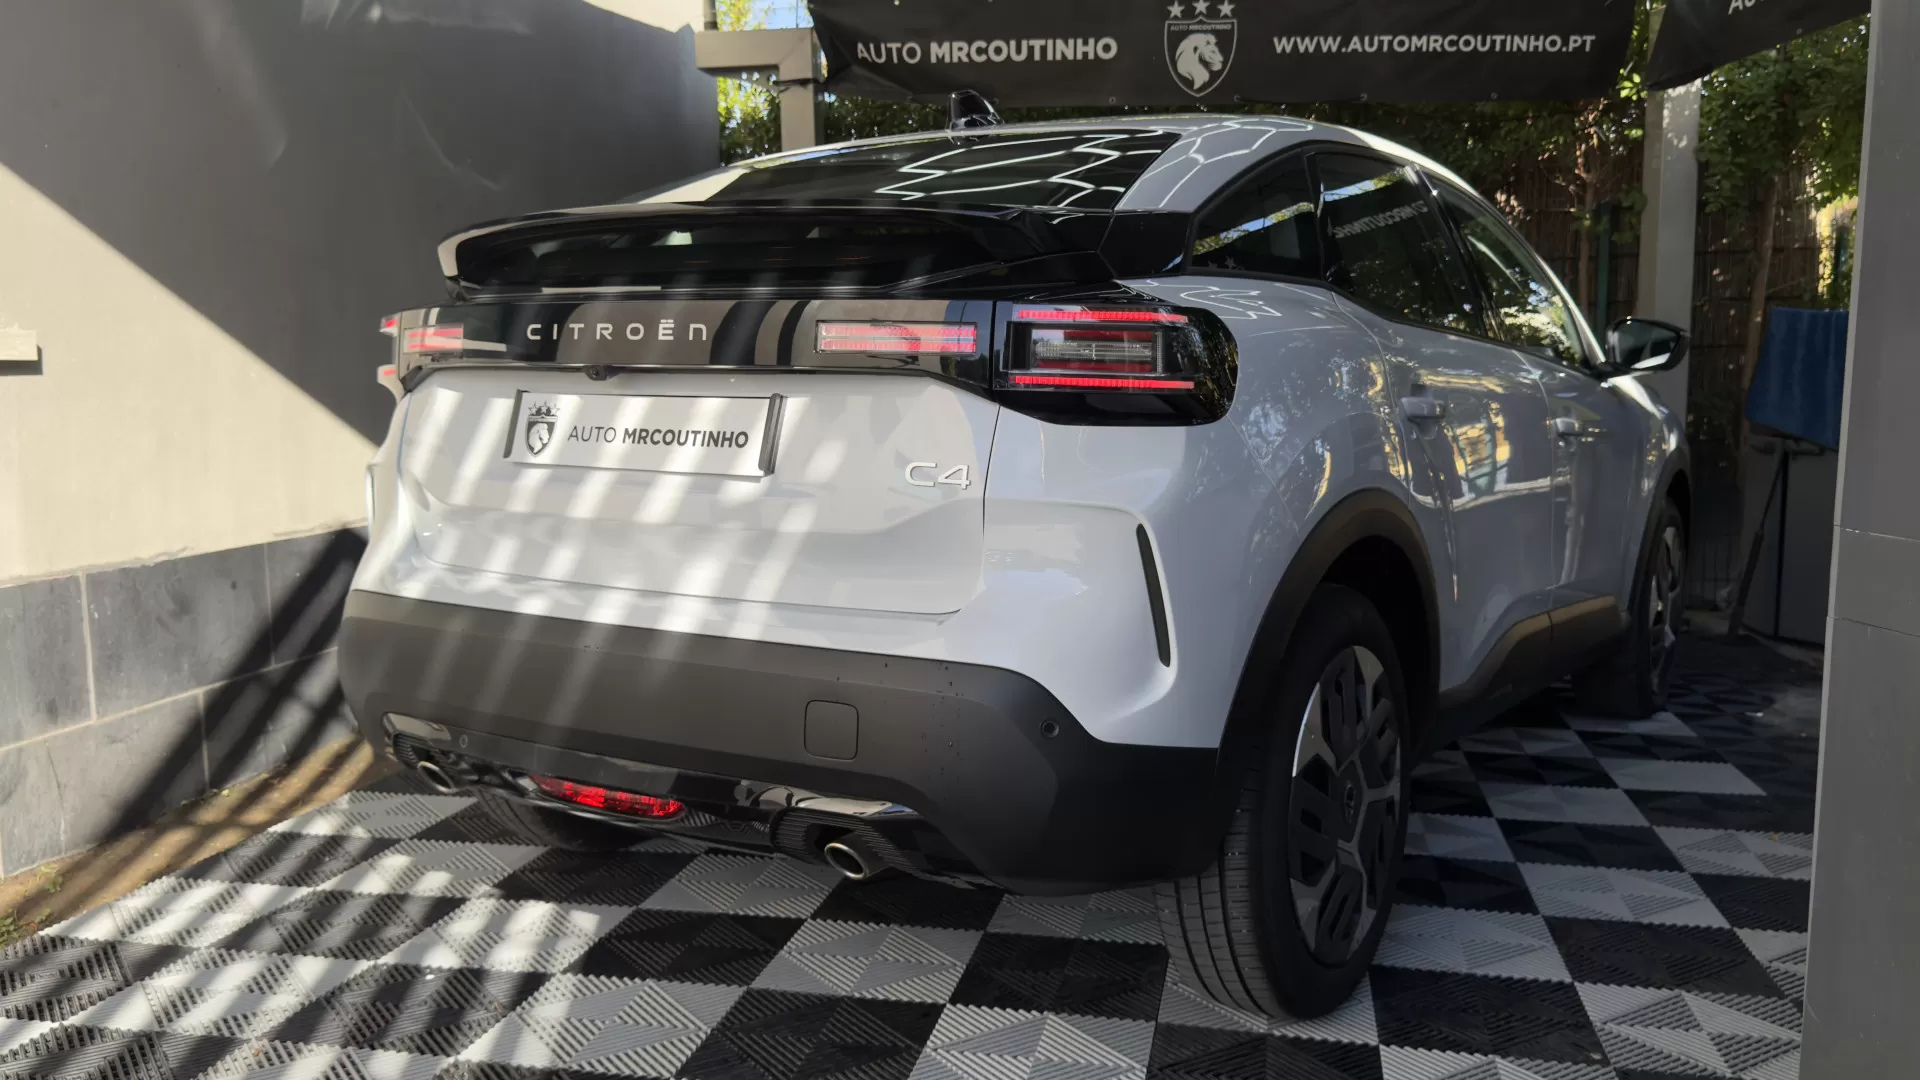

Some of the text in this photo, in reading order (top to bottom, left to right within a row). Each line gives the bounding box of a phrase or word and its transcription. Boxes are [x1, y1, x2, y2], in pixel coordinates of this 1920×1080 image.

[857, 37, 1118, 64] AUTO MRCOUTINHO
[1273, 34, 1596, 54] WWW.AUTOMRCOUTINHO.PT
[526, 319, 707, 341] CITROËN
[568, 425, 749, 449] AUTO MRCOUTINHO
[905, 461, 972, 490] C4
